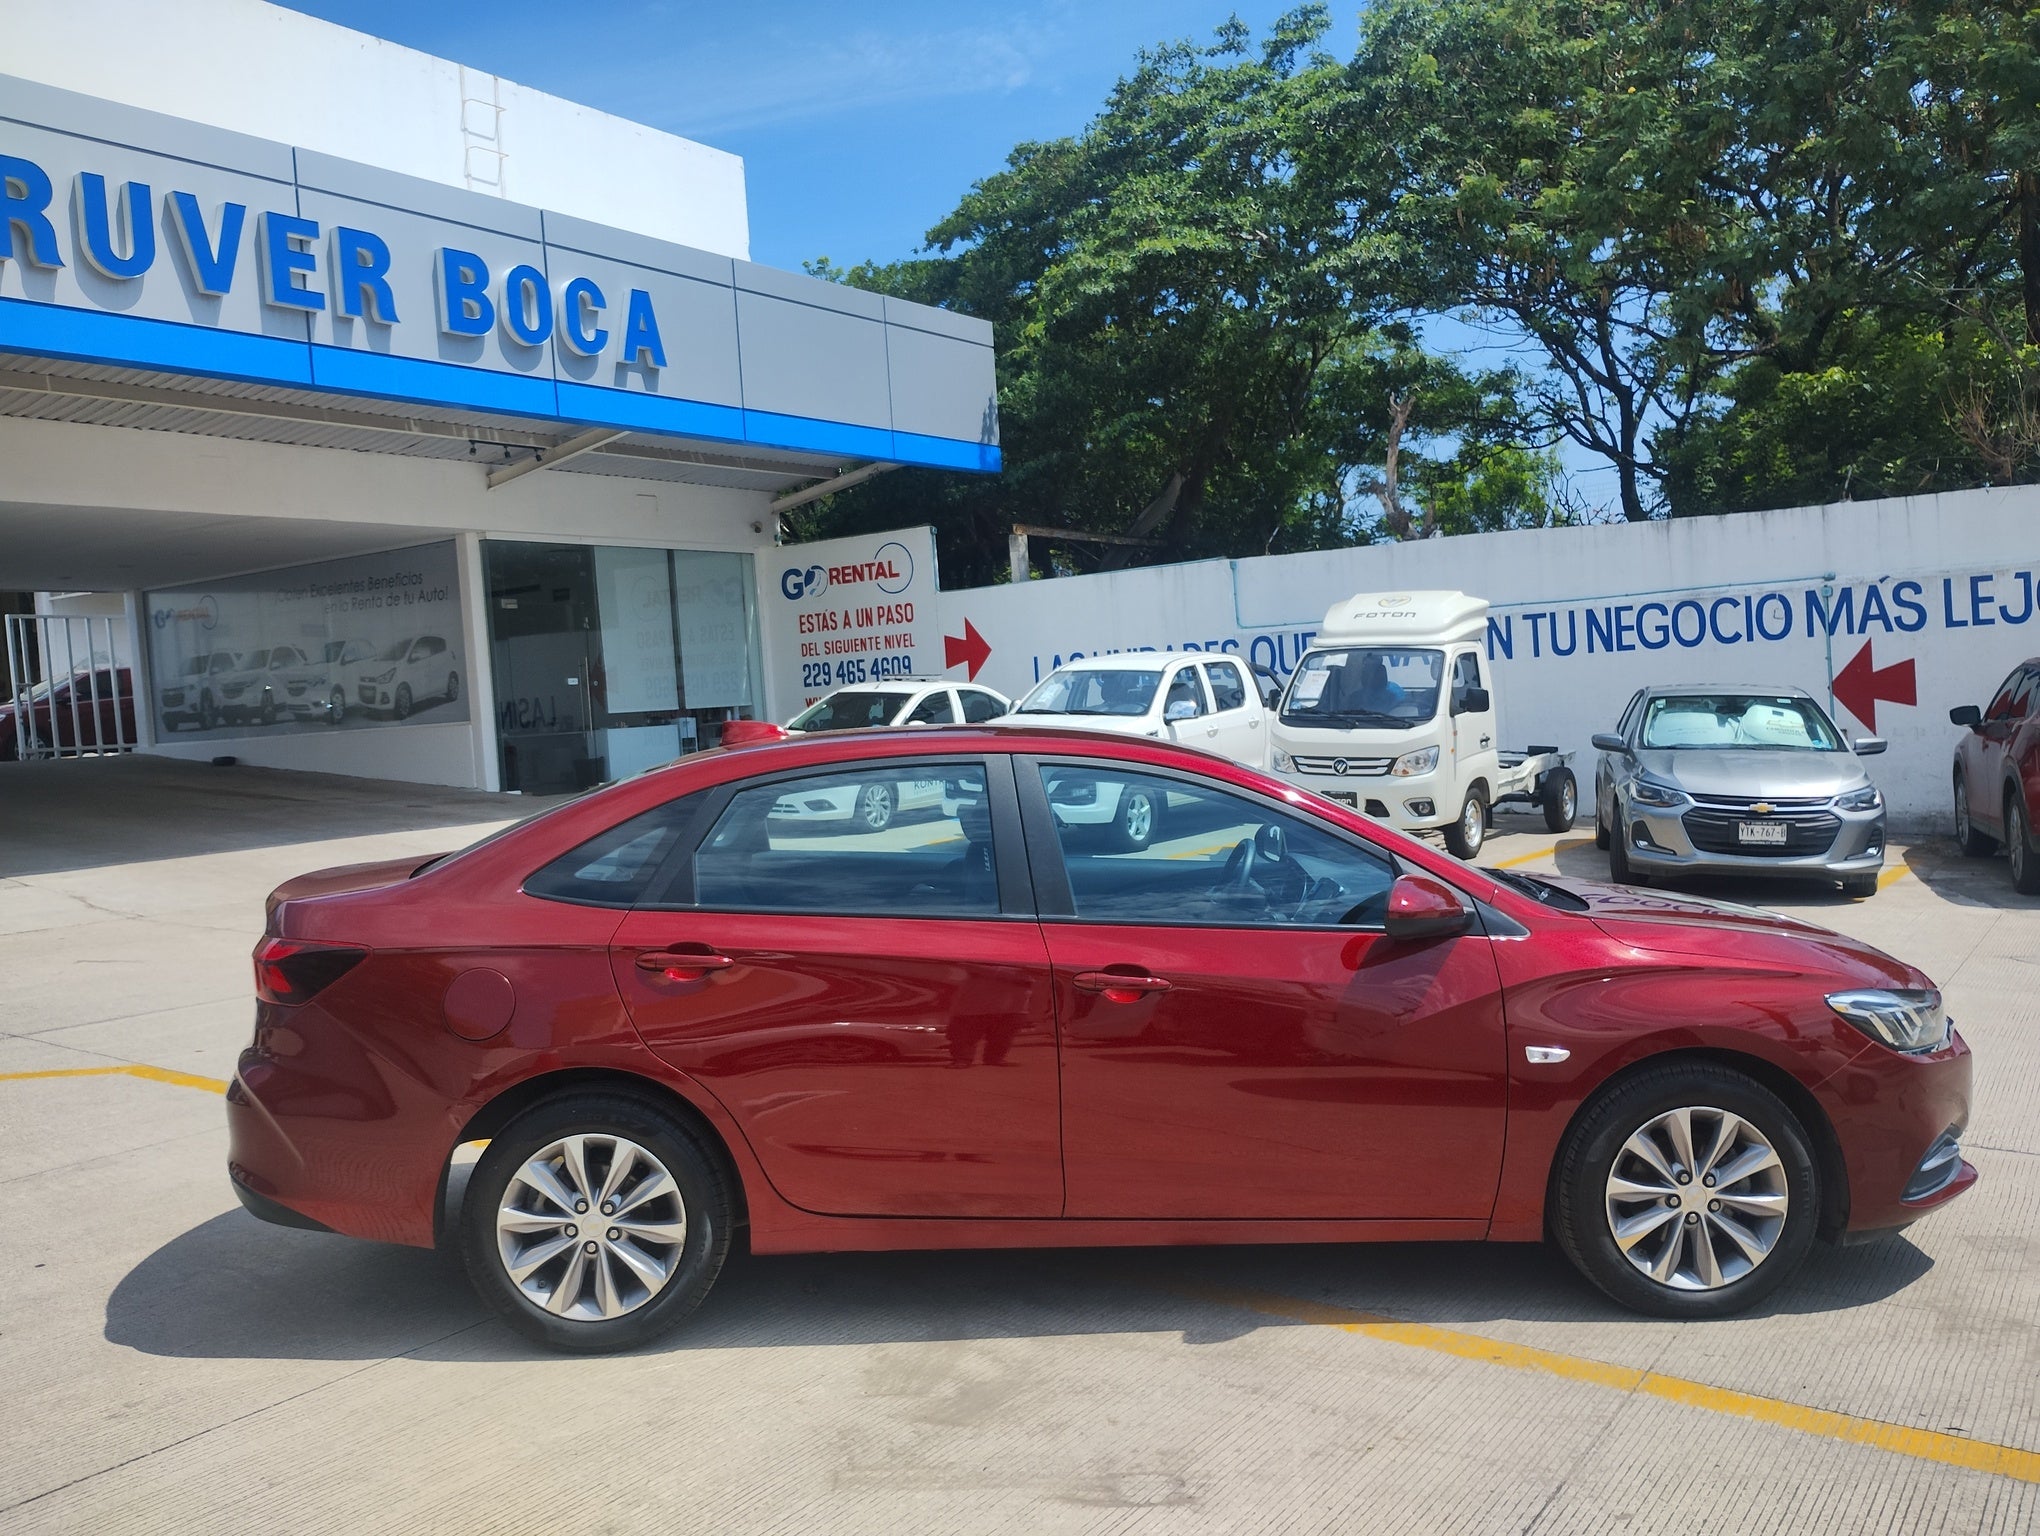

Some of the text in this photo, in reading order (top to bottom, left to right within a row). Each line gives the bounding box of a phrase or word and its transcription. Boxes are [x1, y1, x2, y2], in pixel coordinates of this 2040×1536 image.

[437, 247, 668, 368] BOCA
[310, 580, 365, 599] Excelentes
[368, 572, 423, 592] Beneficios
[828, 560, 900, 586] RENTAL
[351, 597, 382, 611] Renta
[386, 594, 400, 607] de
[404, 591, 414, 605] tu
[418, 586, 449, 603] Auto!
[799, 602, 914, 634] ESTÁS A UN PASO
[1522, 610, 1576, 657] TU
[1585, 593, 1793, 653] NEGOCIO
[1805, 575, 1928, 638] MÁS
[1943, 571, 2040, 629] LEJ
[801, 633, 915, 657] DEL SIGUIENTE NIVEL
[802, 662, 832, 687] 229
[836, 658, 866, 684] 465
